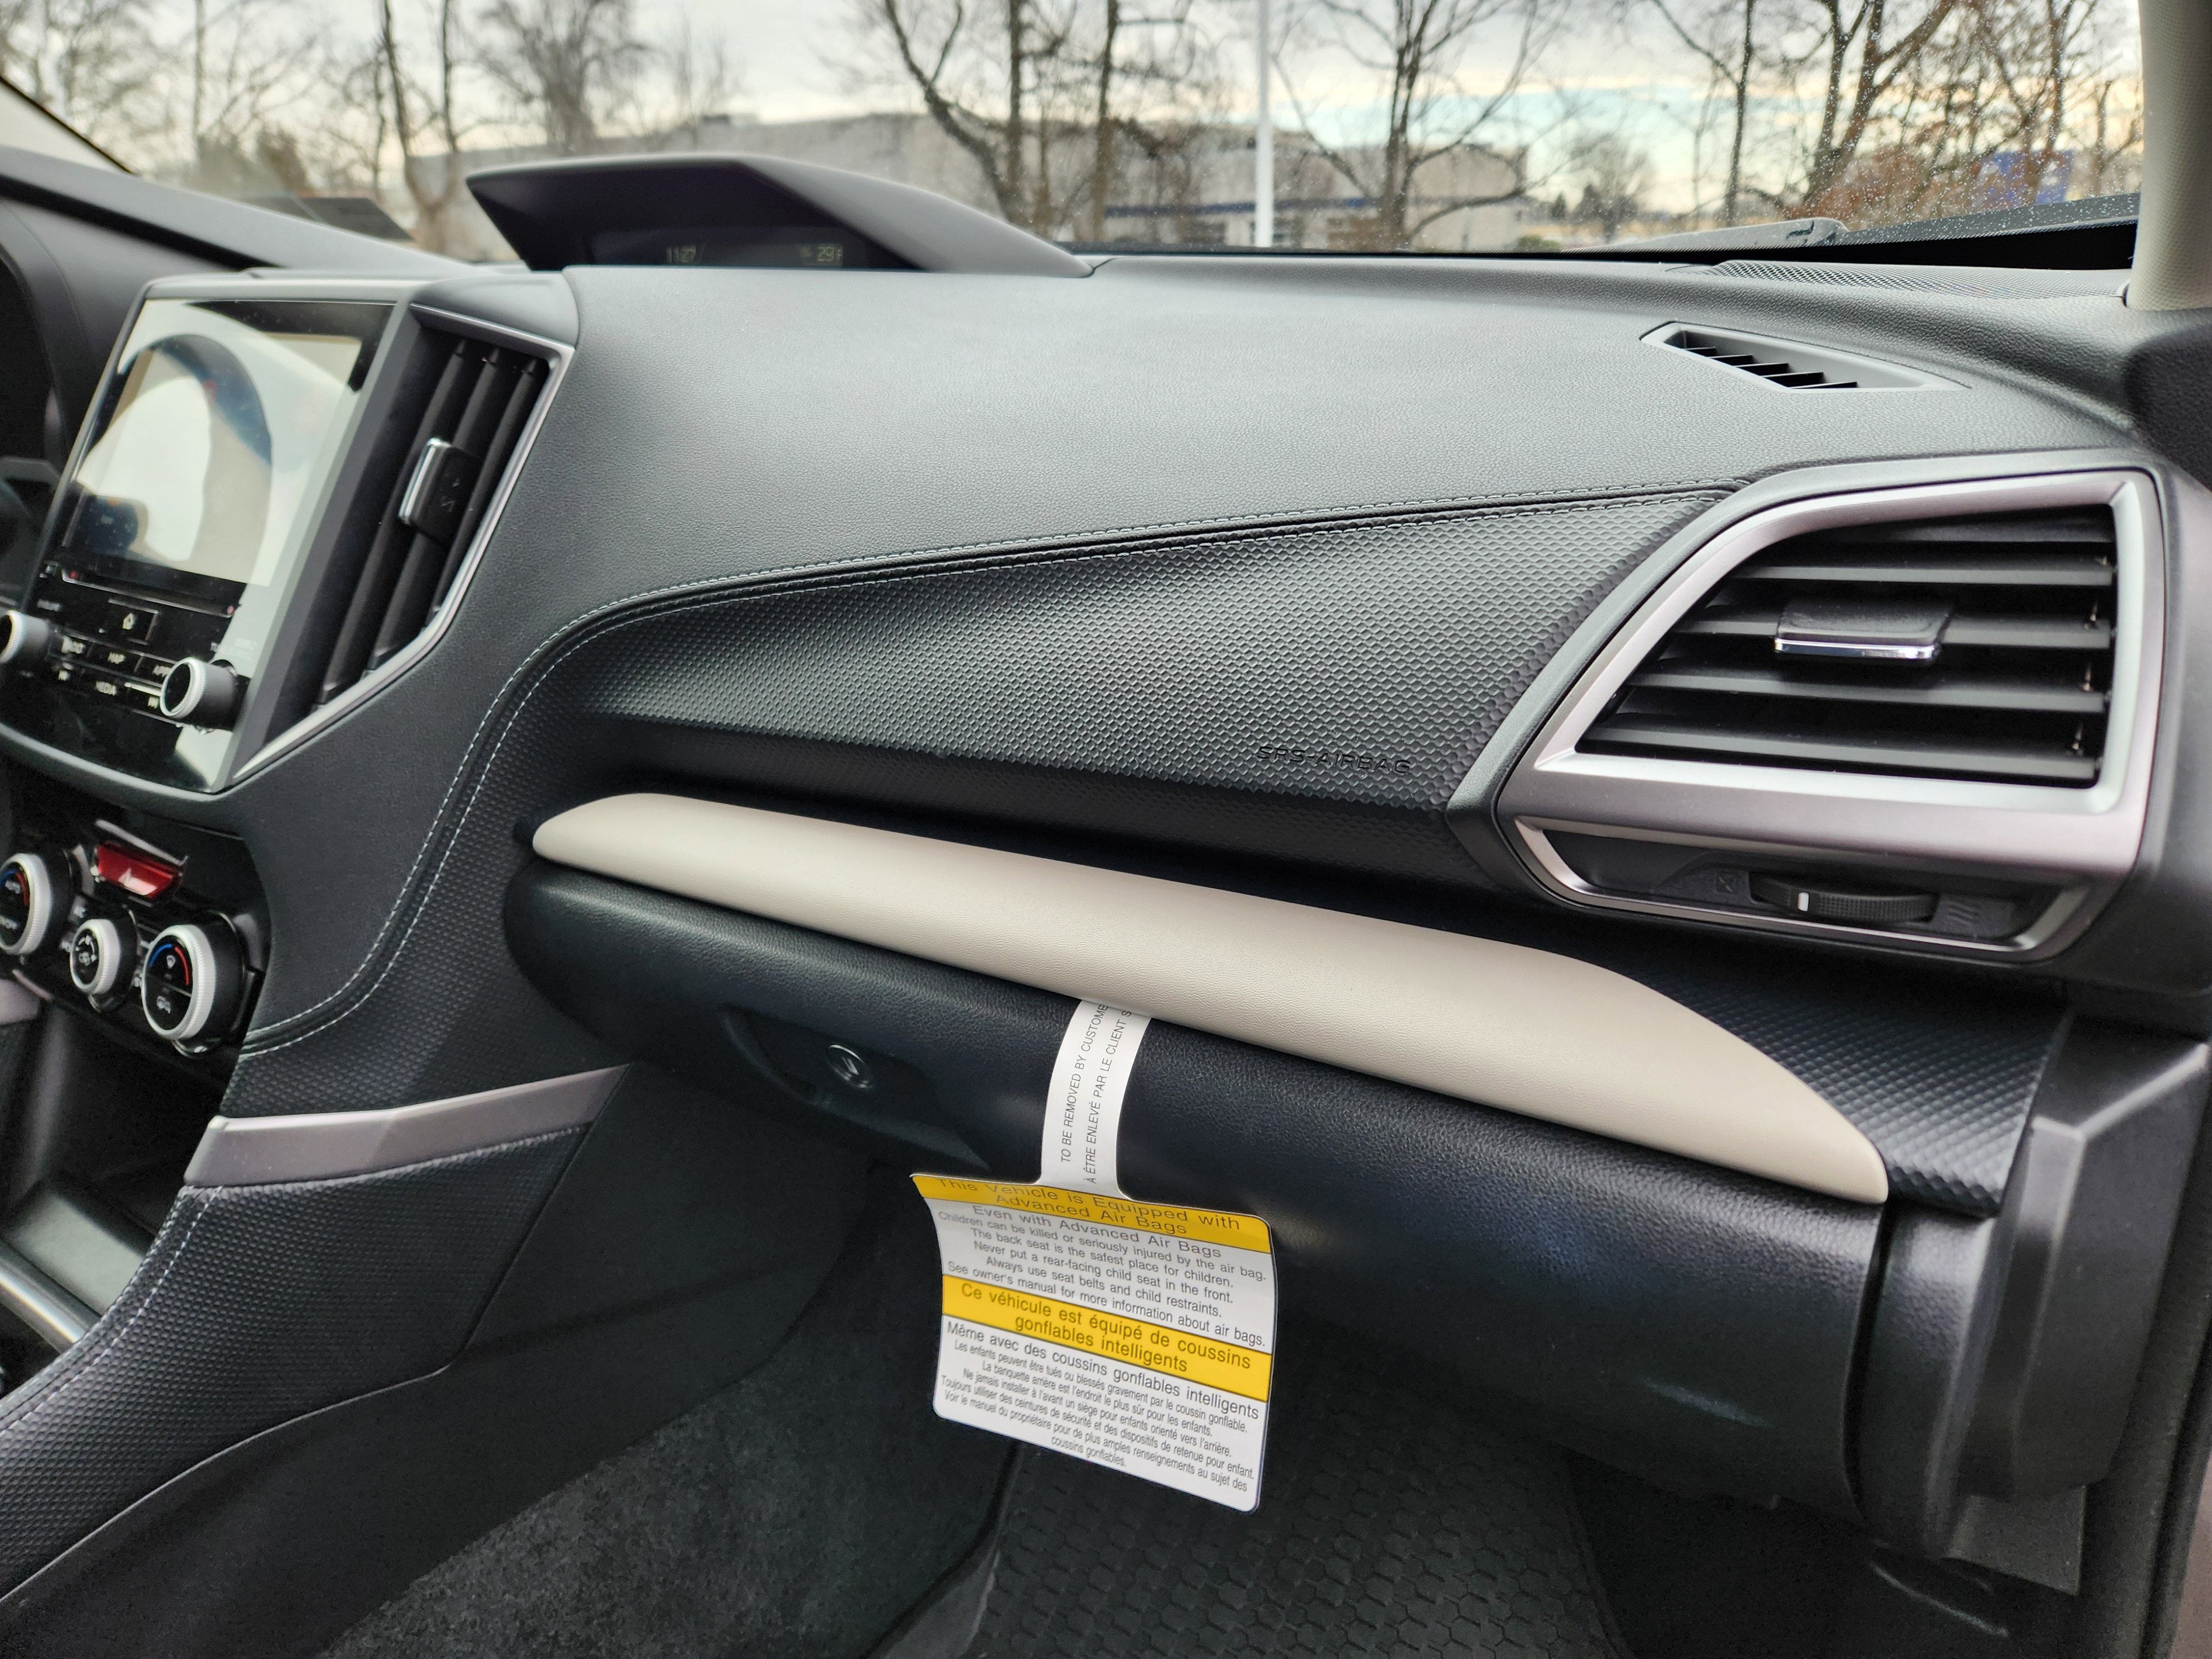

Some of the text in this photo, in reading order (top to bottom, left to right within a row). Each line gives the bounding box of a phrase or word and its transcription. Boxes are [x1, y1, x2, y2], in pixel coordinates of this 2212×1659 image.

[1256, 746, 1411, 774] SRS-AIRBAG
[1075, 1055, 1087, 1070] BY
[1106, 1019, 1127, 1055] CLIENT
[1093, 1075, 1107, 1098] PAR
[1100, 1058, 1113, 1072] LE
[1063, 1073, 1081, 1128] REMOVED
[1086, 1101, 1100, 1144] ENLEVÉ
[1061, 1149, 1071, 1162] TO
[1063, 1130, 1072, 1146] BE
[1083, 1146, 1096, 1174] ÊTRE
[936, 1178, 1240, 1230] This Vehicle is Equipped with
[973, 1205, 1222, 1258] Even with Advanced Air Bags
[997, 1196, 1187, 1234] Advanced Air Bags
[938, 1211, 1266, 1282] Children can be killed or seriously injured by the air bag.
[971, 1228, 1233, 1288] The back seat is the safest place for children.
[974, 1241, 1005, 1255] Never
[1010, 1249, 1027, 1261] put
[1043, 1255, 1100, 1277] rear-facing
[1106, 1268, 1131, 1281] child
[1137, 1274, 1160, 1288] seat
[1166, 1279, 1176, 1291] in
[1181, 1283, 1199, 1295] the
[1204, 1287, 1233, 1303] front.
[948, 1261, 1266, 1347] See owner's manual for more information about air bags.
[986, 1256, 1222, 1317] Always use seat belts and child restraints.
[962, 1283, 1251, 1369] Ce véhicule est équipé de coussins
[1015, 1316, 1188, 1373] gonflables intelligents
[947, 1321, 1259, 1420] Même avec des coussins gonflables intelligents
[954, 1339, 1247, 1433] Les enfants peuvent être tués ou blessés gravement par le coussin gonflable.
[963, 1368, 974, 1380] Ne
[975, 1371, 999, 1387] jamais
[1001, 1378, 1029, 1396] installer
[1066, 1398, 1075, 1409] un
[1077, 1400, 1098, 1417] siège
[1100, 1410, 1118, 1422] pour
[1120, 1415, 1148, 1431] enfants
[1151, 1423, 1178, 1440] orienté
[1180, 1433, 1197, 1446] vers
[982, 1360, 992, 1371] La
[994, 1364, 1030, 1383] banquette
[1032, 1375, 1056, 1390] arrière
[1058, 1383, 1070, 1394] est
[1104, 1395, 1111, 1406] le
[1114, 1398, 1130, 1411] plus
[1133, 1404, 1145, 1416] sûr
[1147, 1410, 1165, 1422] pour
[1168, 1413, 1179, 1425] les
[1181, 1419, 1213, 1437] enfants.
[941, 1375, 1255, 1480] Toujours utiliser des ceintures de sécurité et des dispositifs de retenue pour enfant.
[945, 1389, 1248, 1492] Voir le manuel du propriétaire pour de plus amples renseignements au sujet des
[1051, 1436, 1126, 1467] coussins gonflables.
